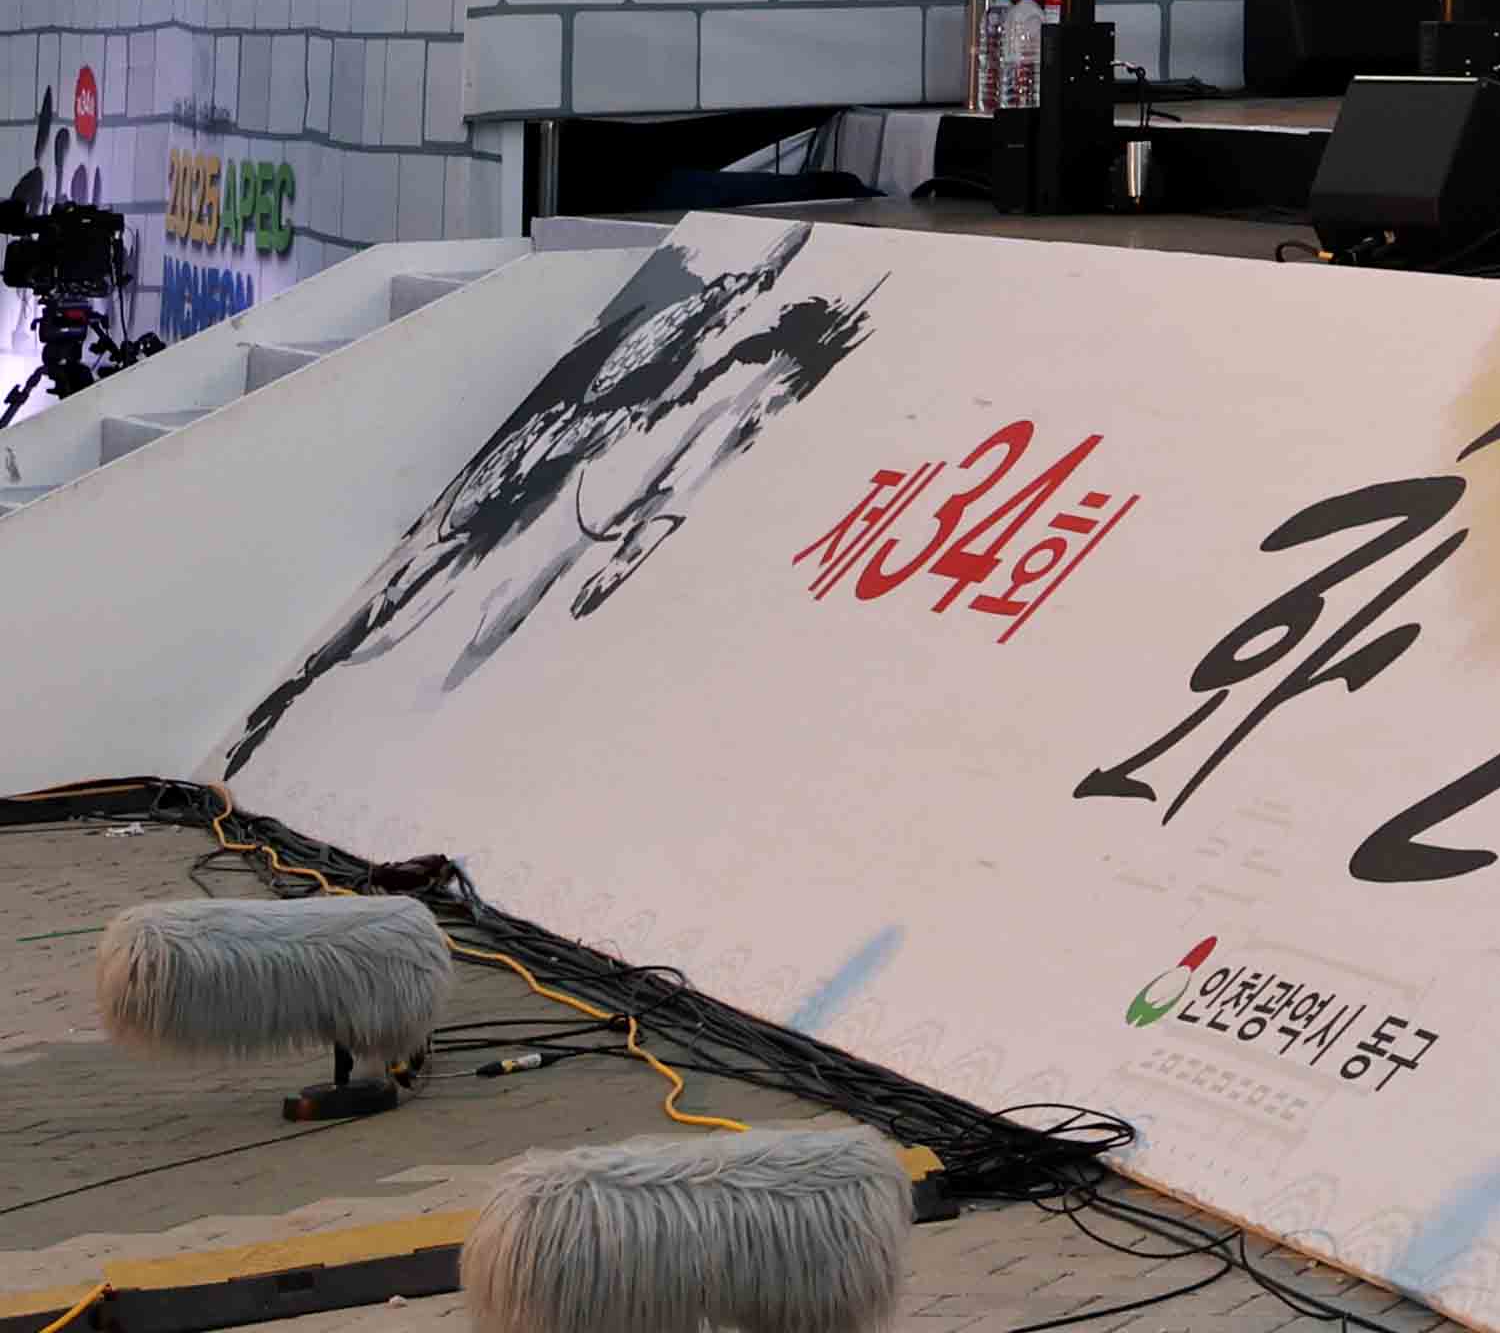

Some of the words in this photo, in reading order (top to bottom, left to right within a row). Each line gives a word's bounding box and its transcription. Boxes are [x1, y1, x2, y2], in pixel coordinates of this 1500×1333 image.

[164, 148, 221, 246] 2025
[220, 158, 295, 255] APEC
[793, 420, 1141, 645] 제34회
[1176, 966, 1367, 1066] 인천광역시
[1339, 1016, 1440, 1093] 동구
